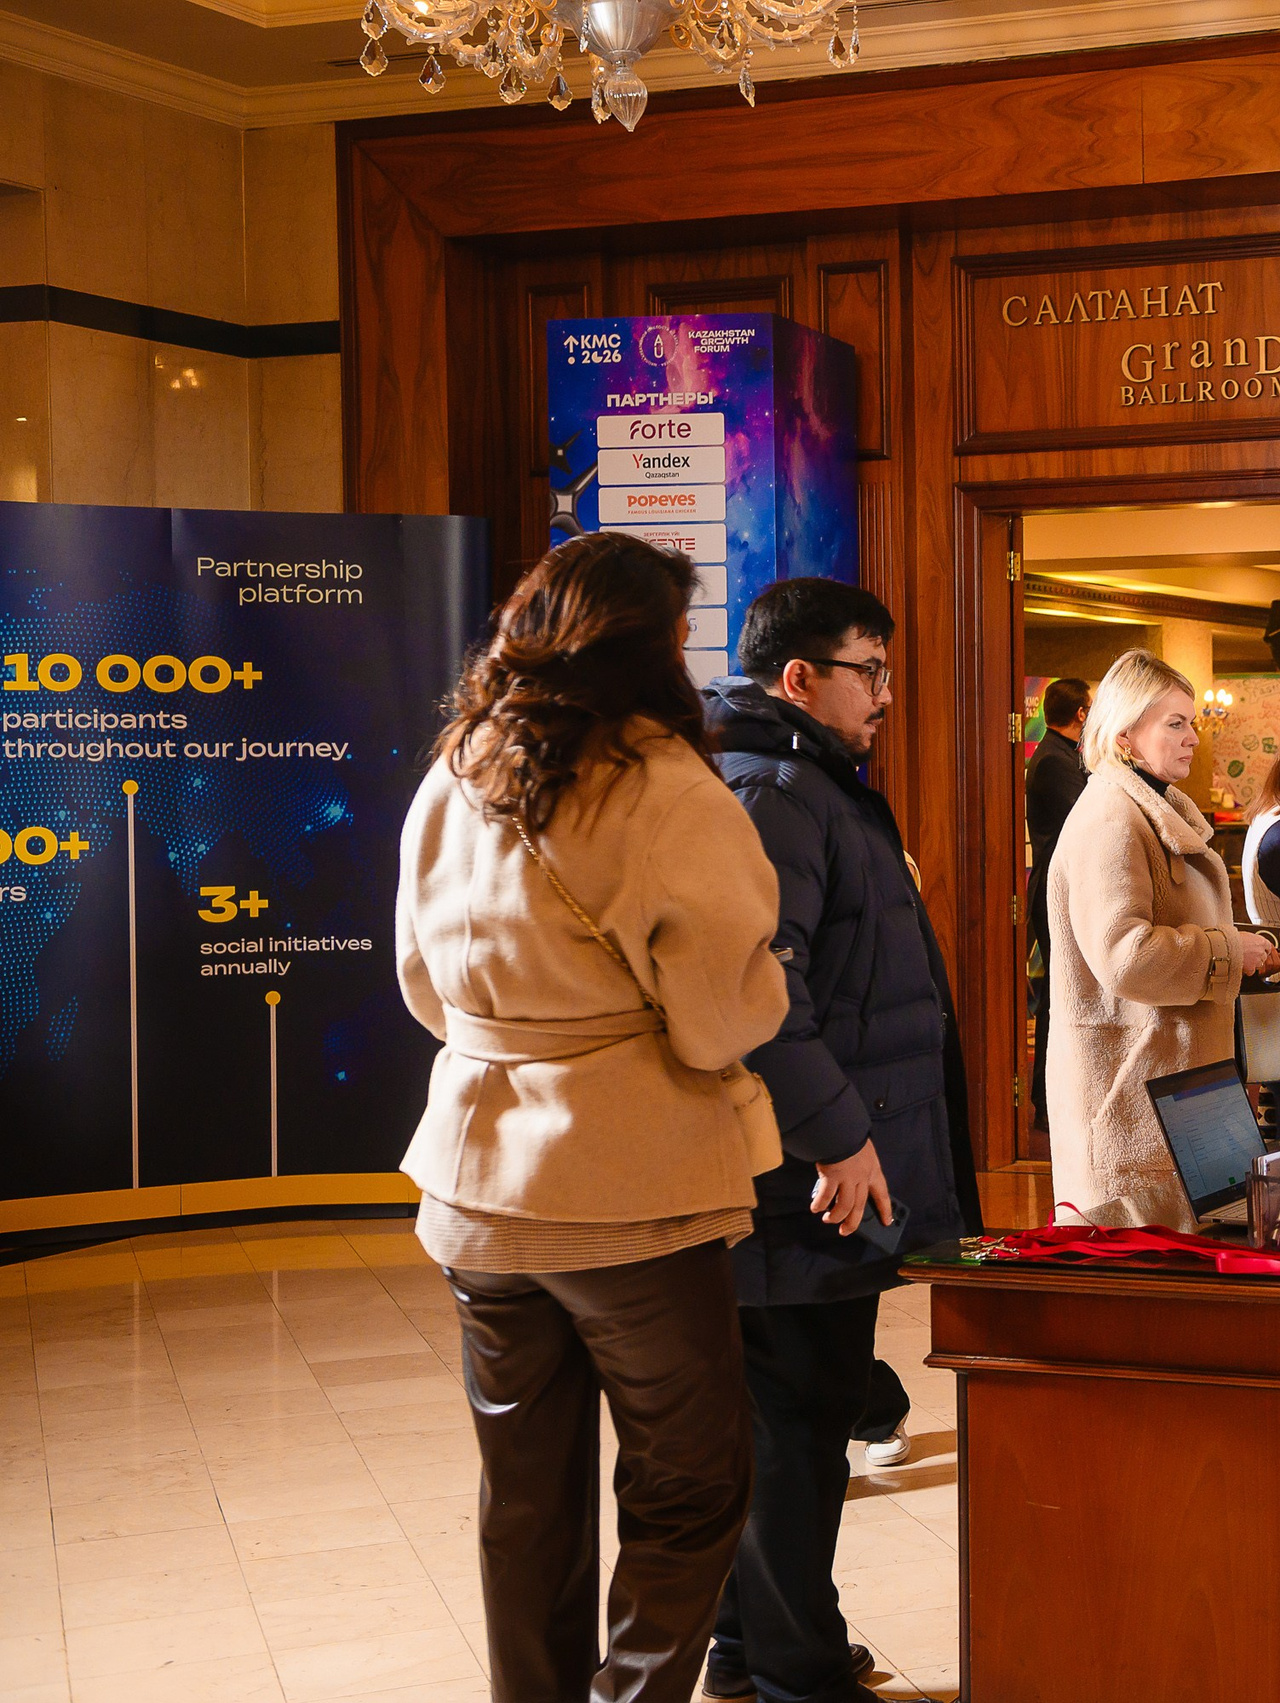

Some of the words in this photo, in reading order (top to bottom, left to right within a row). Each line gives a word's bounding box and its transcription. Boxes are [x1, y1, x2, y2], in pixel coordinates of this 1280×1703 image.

[1002, 281, 1223, 327] САЛТАНАТ
[581, 333, 622, 349] KMC
[688, 329, 755, 339] KAZAKHSTAN
[700, 337, 749, 346] GROWTH
[581, 349, 622, 364] 2026
[694, 345, 730, 353] FORUM
[606, 391, 714, 408] ПАРТНЕРЫ
[629, 419, 692, 439] Forte
[632, 452, 691, 469] Yandex
[197, 556, 363, 583] Partnership
[238, 583, 363, 606] platform
[3, 653, 83, 692] 10
[96, 653, 263, 694] 000+
[2, 708, 188, 733] participants
[2, 738, 176, 762] throughout
[183, 742, 233, 758] our
[236, 737, 349, 762] journey
[198, 885, 269, 923] 3+
[200, 937, 264, 955] social
[268, 935, 373, 952] initiatives
[200, 958, 292, 976] annually
